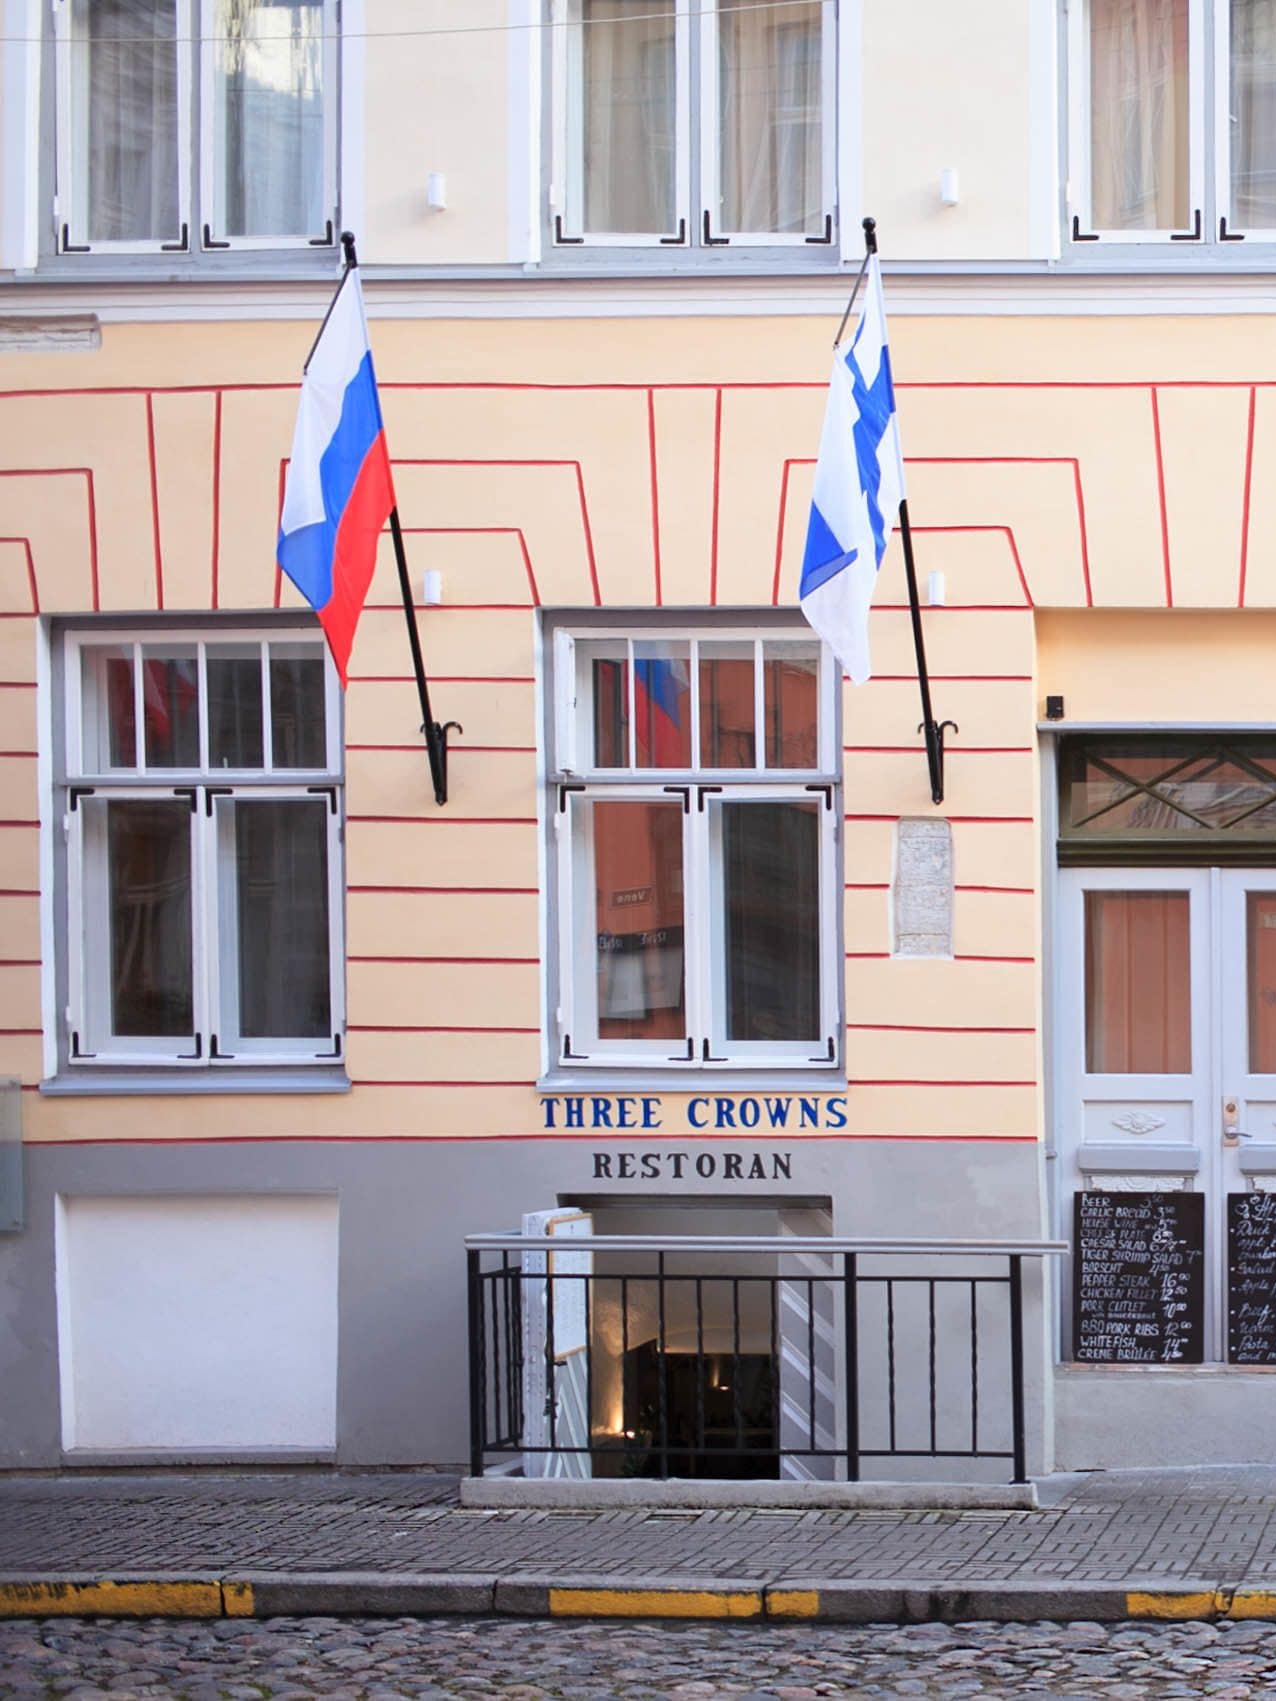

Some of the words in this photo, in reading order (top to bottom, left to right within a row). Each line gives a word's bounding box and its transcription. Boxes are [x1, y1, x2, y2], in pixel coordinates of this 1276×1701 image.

[540, 1097, 662, 1128] THREE
[687, 1097, 849, 1128] CROWNS
[593, 1153, 793, 1180] RESTORAN
[1082, 1193, 1110, 1207] BEER
[1080, 1238, 1115, 1249] CAESAR
[1119, 1240, 1146, 1251] SALAD
[1081, 1248, 1109, 1260] TIGER
[1112, 1250, 1151, 1263] SHRIMP
[1151, 1252, 1183, 1265] SALAD
[1081, 1274, 1116, 1287] PEPPER
[1119, 1275, 1151, 1288] STEAK
[1080, 1287, 1124, 1298] CHICKEN
[1081, 1319, 1104, 1334] BBQ
[1105, 1322, 1131, 1335] PORK
[1134, 1322, 1160, 1336] RIBS
